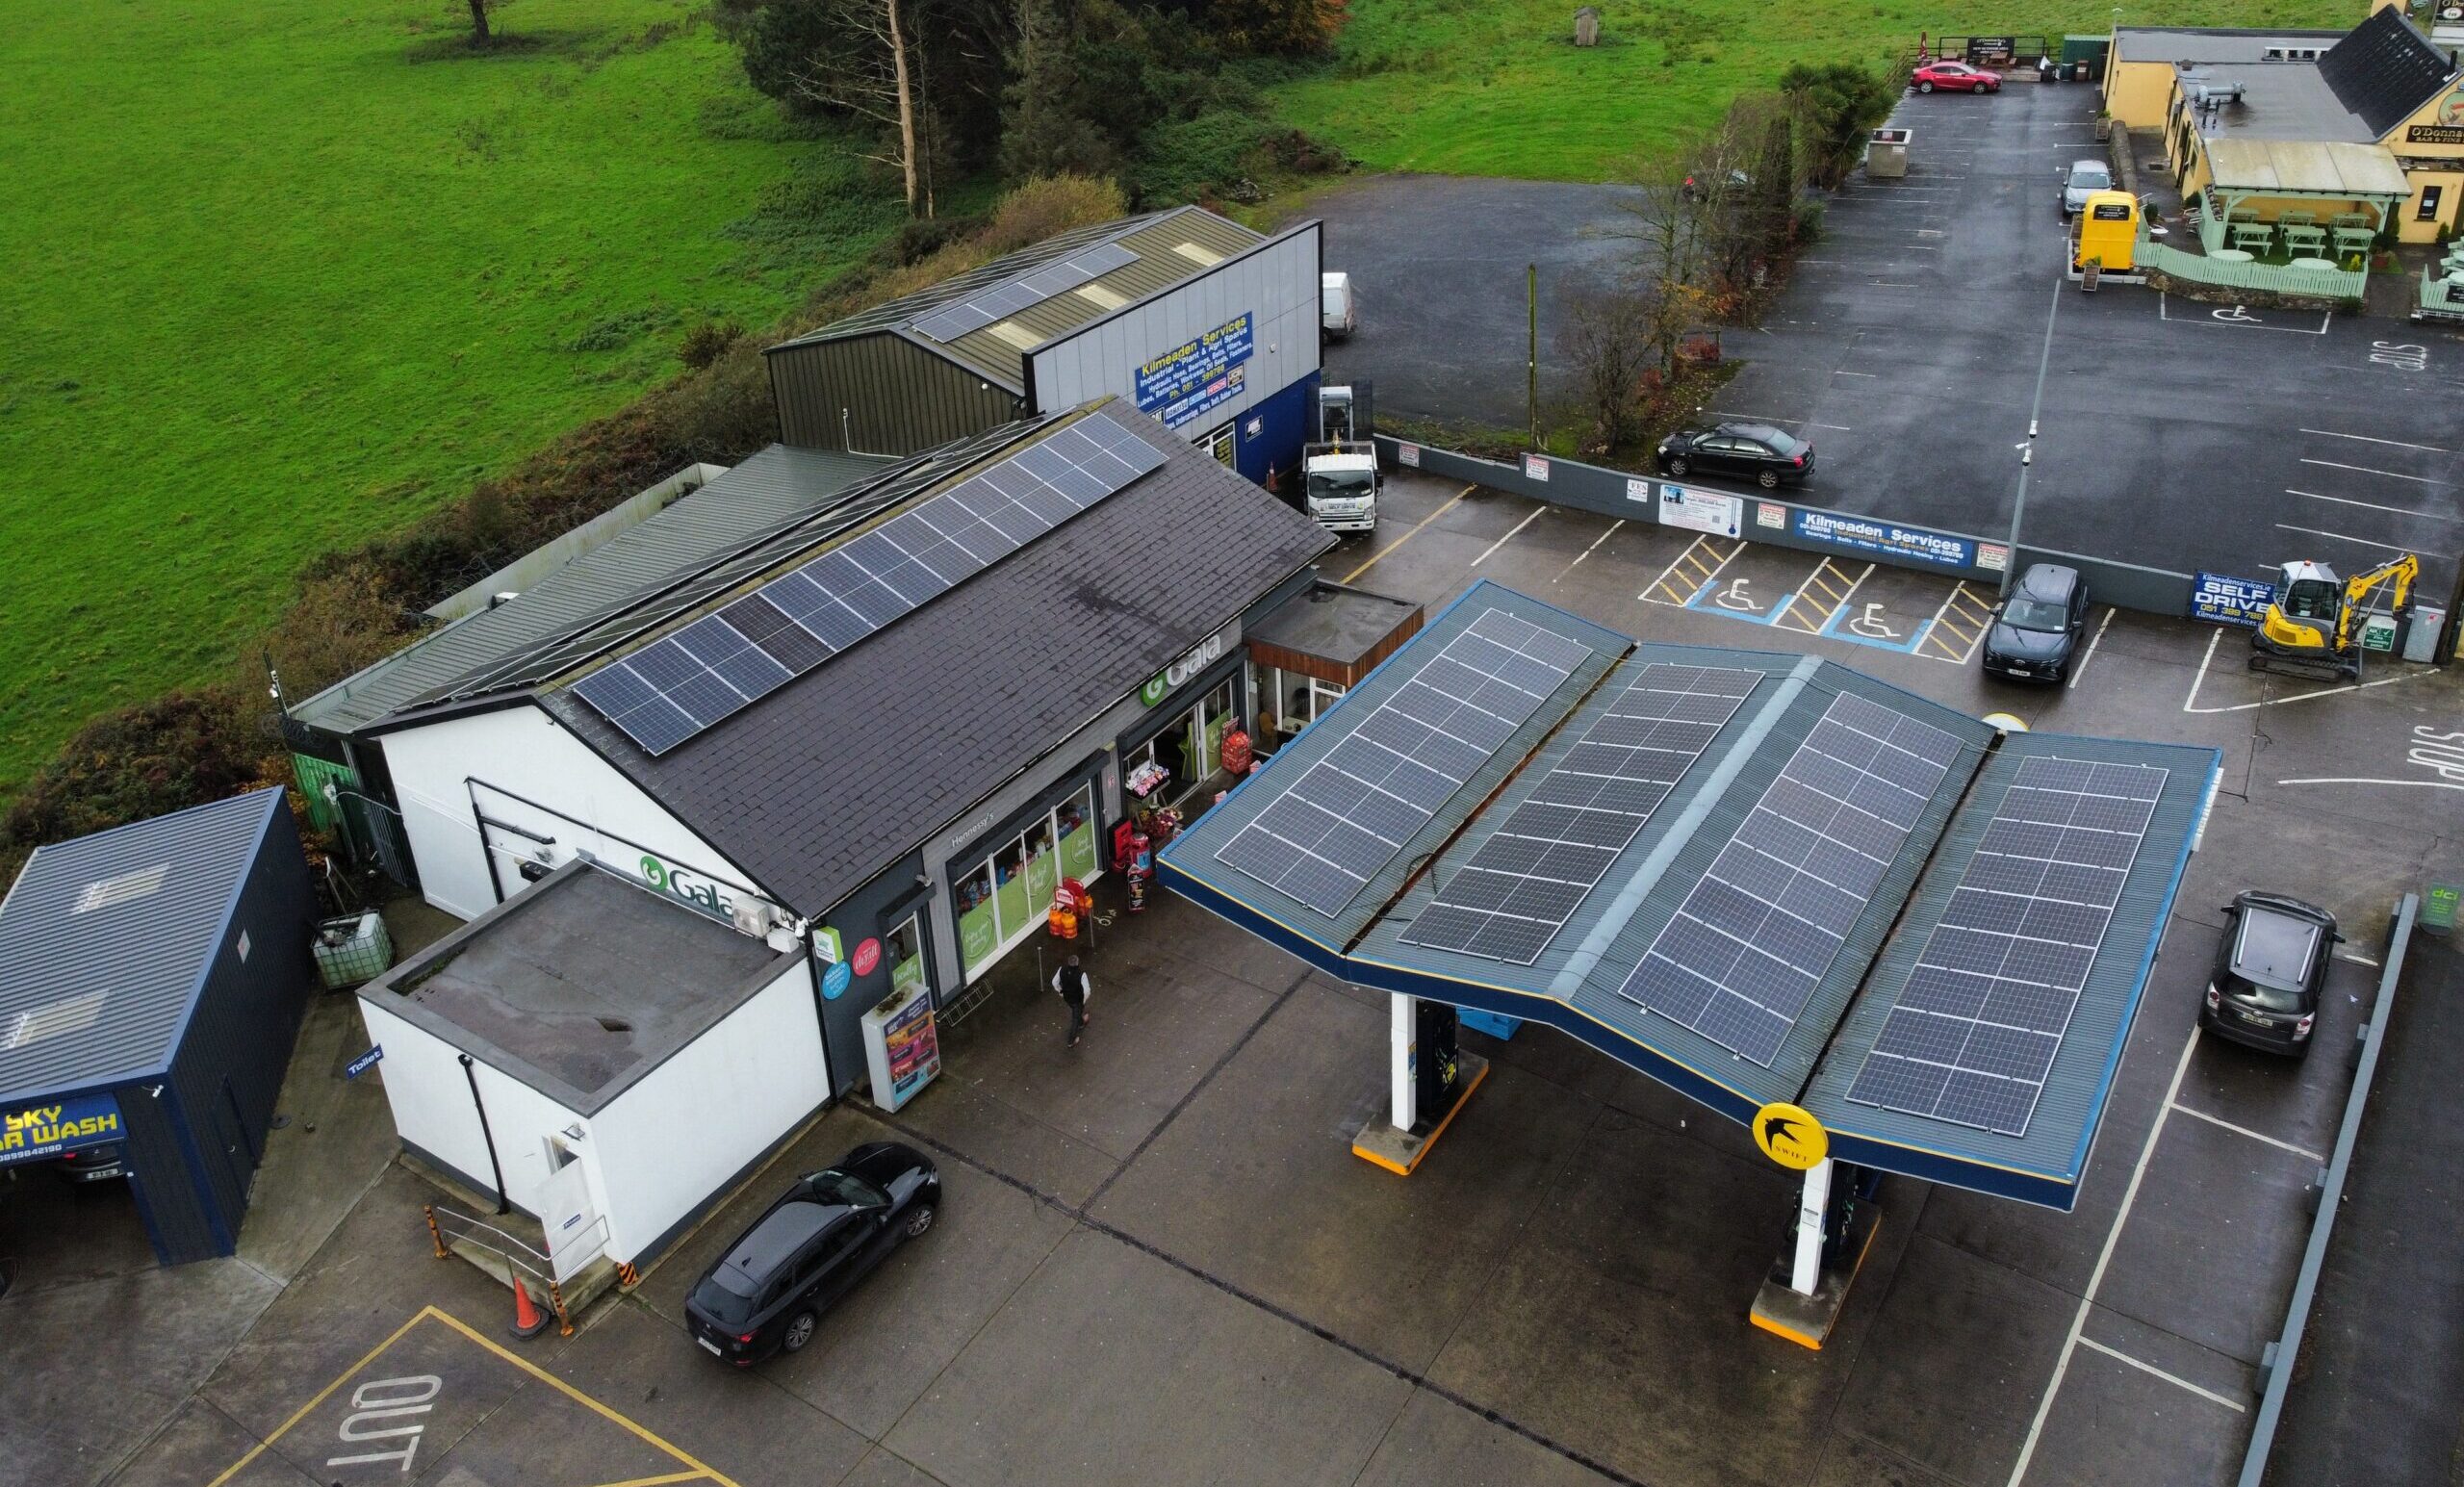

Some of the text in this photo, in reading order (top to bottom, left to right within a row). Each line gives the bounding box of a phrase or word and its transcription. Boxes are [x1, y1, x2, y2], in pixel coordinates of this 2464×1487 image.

[1141, 363, 1173, 387] Industrial
[1182, 351, 1198, 366] Plant
[1209, 339, 1221, 352] Agri
[1224, 327, 1247, 344] Spares
[1142, 317, 1246, 376] Kilmeaden Services
[1182, 381, 1193, 392] 051
[1806, 513, 1883, 537] Kilmeaden
[1891, 529, 1962, 551] Services
[1806, 530, 1832, 540] Bearings
[2203, 574, 2271, 592] Kilmeadenservices.ie
[2204, 581, 2268, 600] SELF
[2194, 591, 2270, 614] DRIVE
[2200, 603, 2218, 612] 051
[2221, 606, 2241, 617] 399
[1167, 634, 1220, 686] Gala
[951, 812, 993, 847] Hennessy's
[6, 1105, 62, 1132] SKY
[32, 1114, 117, 1144] WASH
[1775, 1145, 1810, 1163] SWIFT
[327, 1374, 443, 1471] OUT
